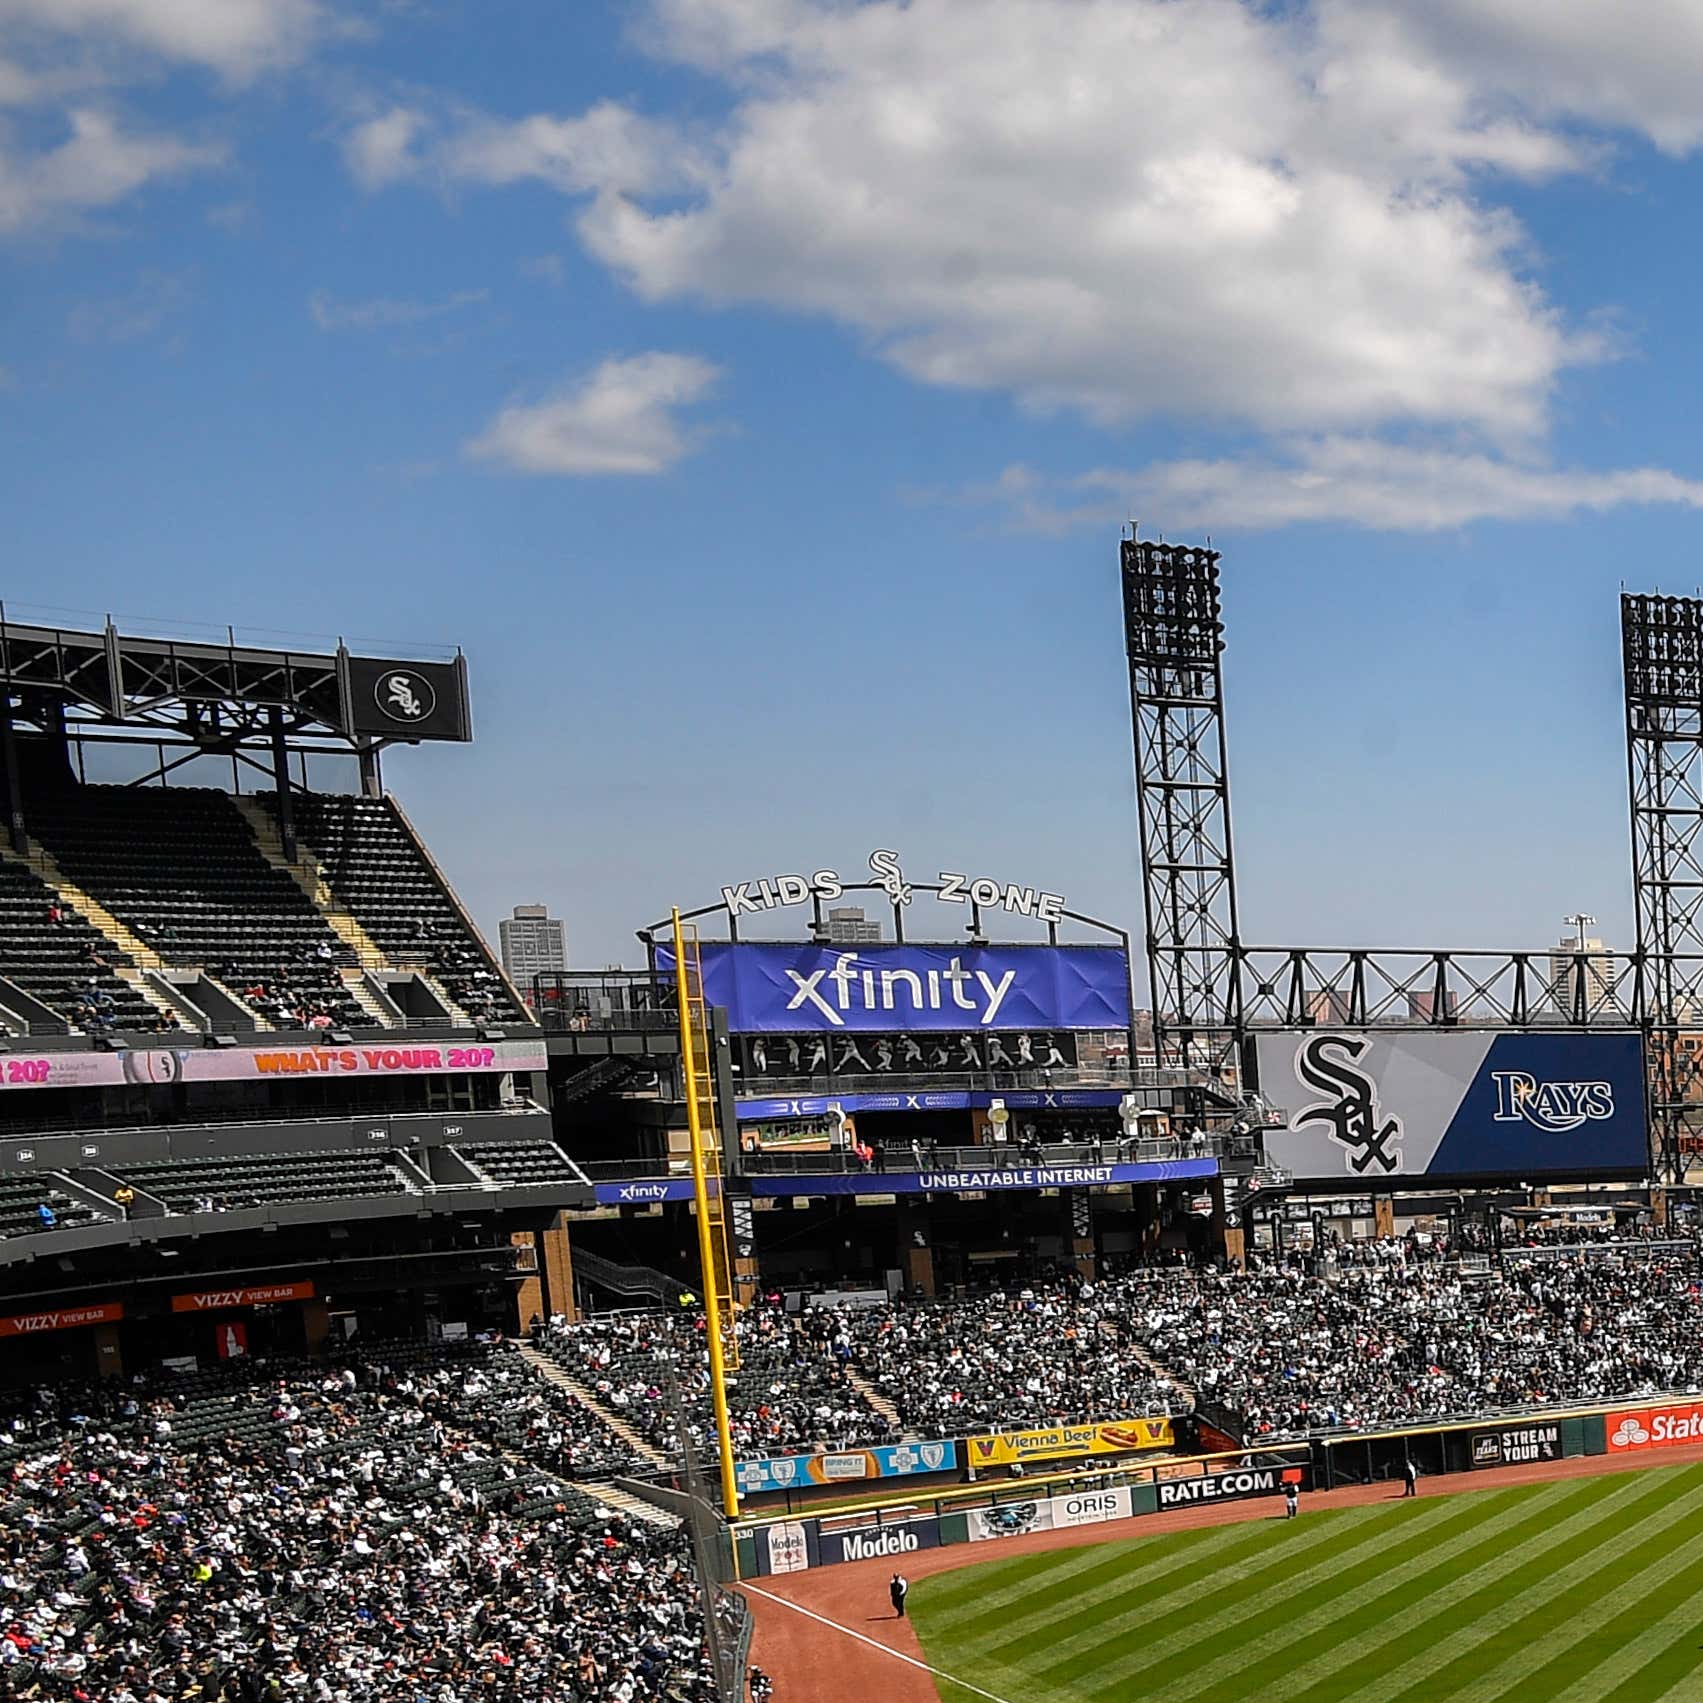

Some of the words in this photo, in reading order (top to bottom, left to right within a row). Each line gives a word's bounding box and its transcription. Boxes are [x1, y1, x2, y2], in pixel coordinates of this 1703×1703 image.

[721, 868, 843, 916] KIDS
[937, 871, 1066, 922] ZONE
[785, 952, 1018, 1026] xfinity
[253, 1047, 357, 1072] WHAT'S
[363, 1049, 443, 1071] YOUR
[446, 1047, 496, 1069] 20?
[919, 1170, 1033, 1192] UNBEATABLE
[1035, 1165, 1113, 1188] INTERNET
[619, 1183, 669, 1202] xfinity
[194, 1289, 244, 1307] VIZZY
[247, 1289, 272, 1301] VIEW
[273, 1287, 293, 1299] BAR
[14, 1312, 60, 1331] VIZZY
[62, 1313, 83, 1324] VIEW
[84, 1309, 104, 1321] BAR
[1004, 1433, 1059, 1449] Vienna
[1063, 1427, 1098, 1443] Beef
[1502, 1427, 1557, 1447] STREAM
[1503, 1444, 1539, 1462] YOUR
[1161, 1471, 1275, 1504] RATE.COM
[1066, 1494, 1118, 1515] ORIS
[771, 1535, 803, 1551] Modelo
[842, 1529, 919, 1562] Modelo
